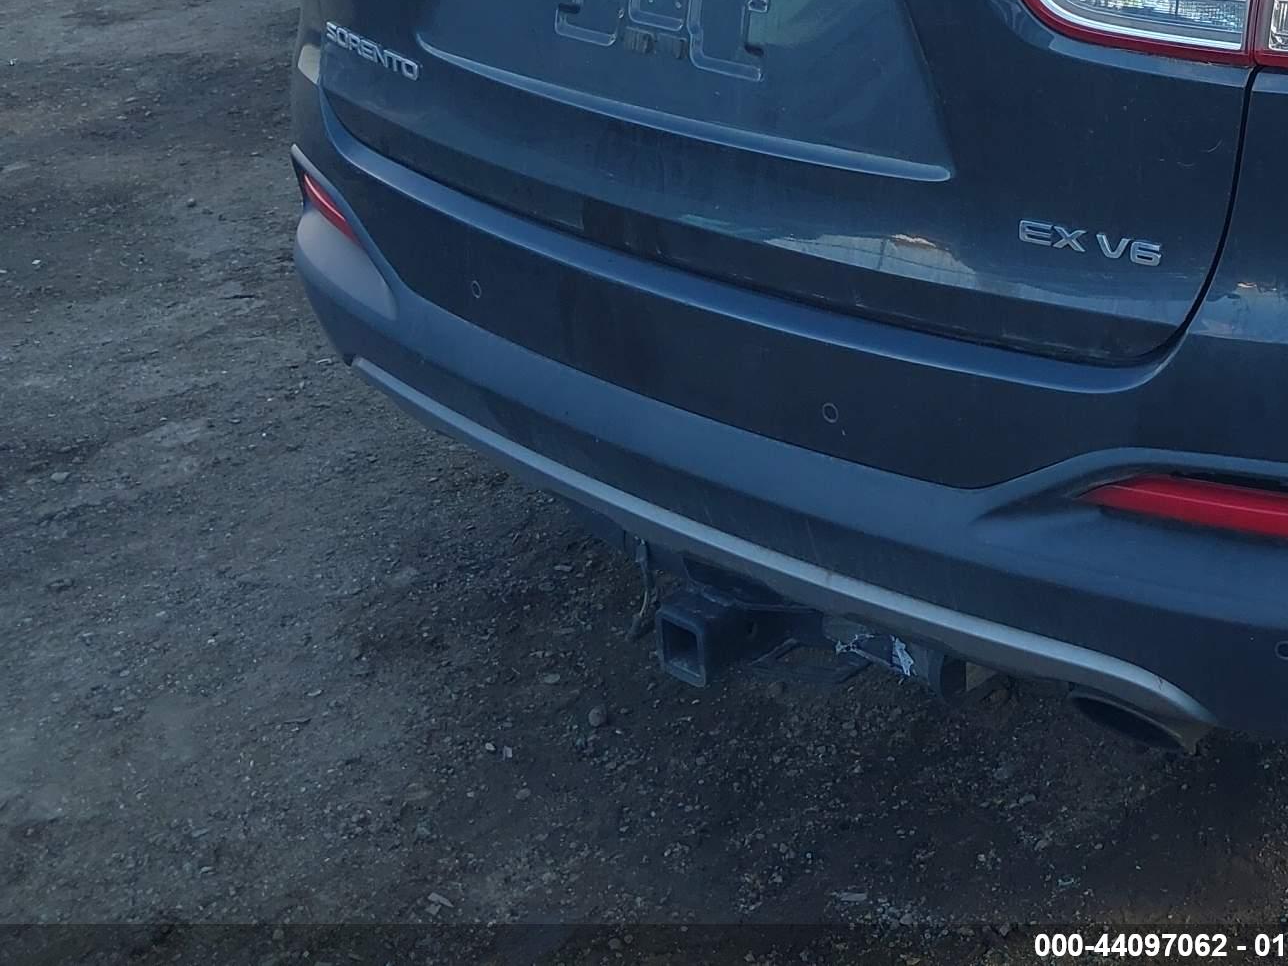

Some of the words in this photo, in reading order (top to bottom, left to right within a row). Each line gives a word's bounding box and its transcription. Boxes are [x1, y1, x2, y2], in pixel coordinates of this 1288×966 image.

[326, 21, 419, 81] SORENTO
[1019, 219, 1087, 252] EX
[1096, 233, 1162, 266] V6
